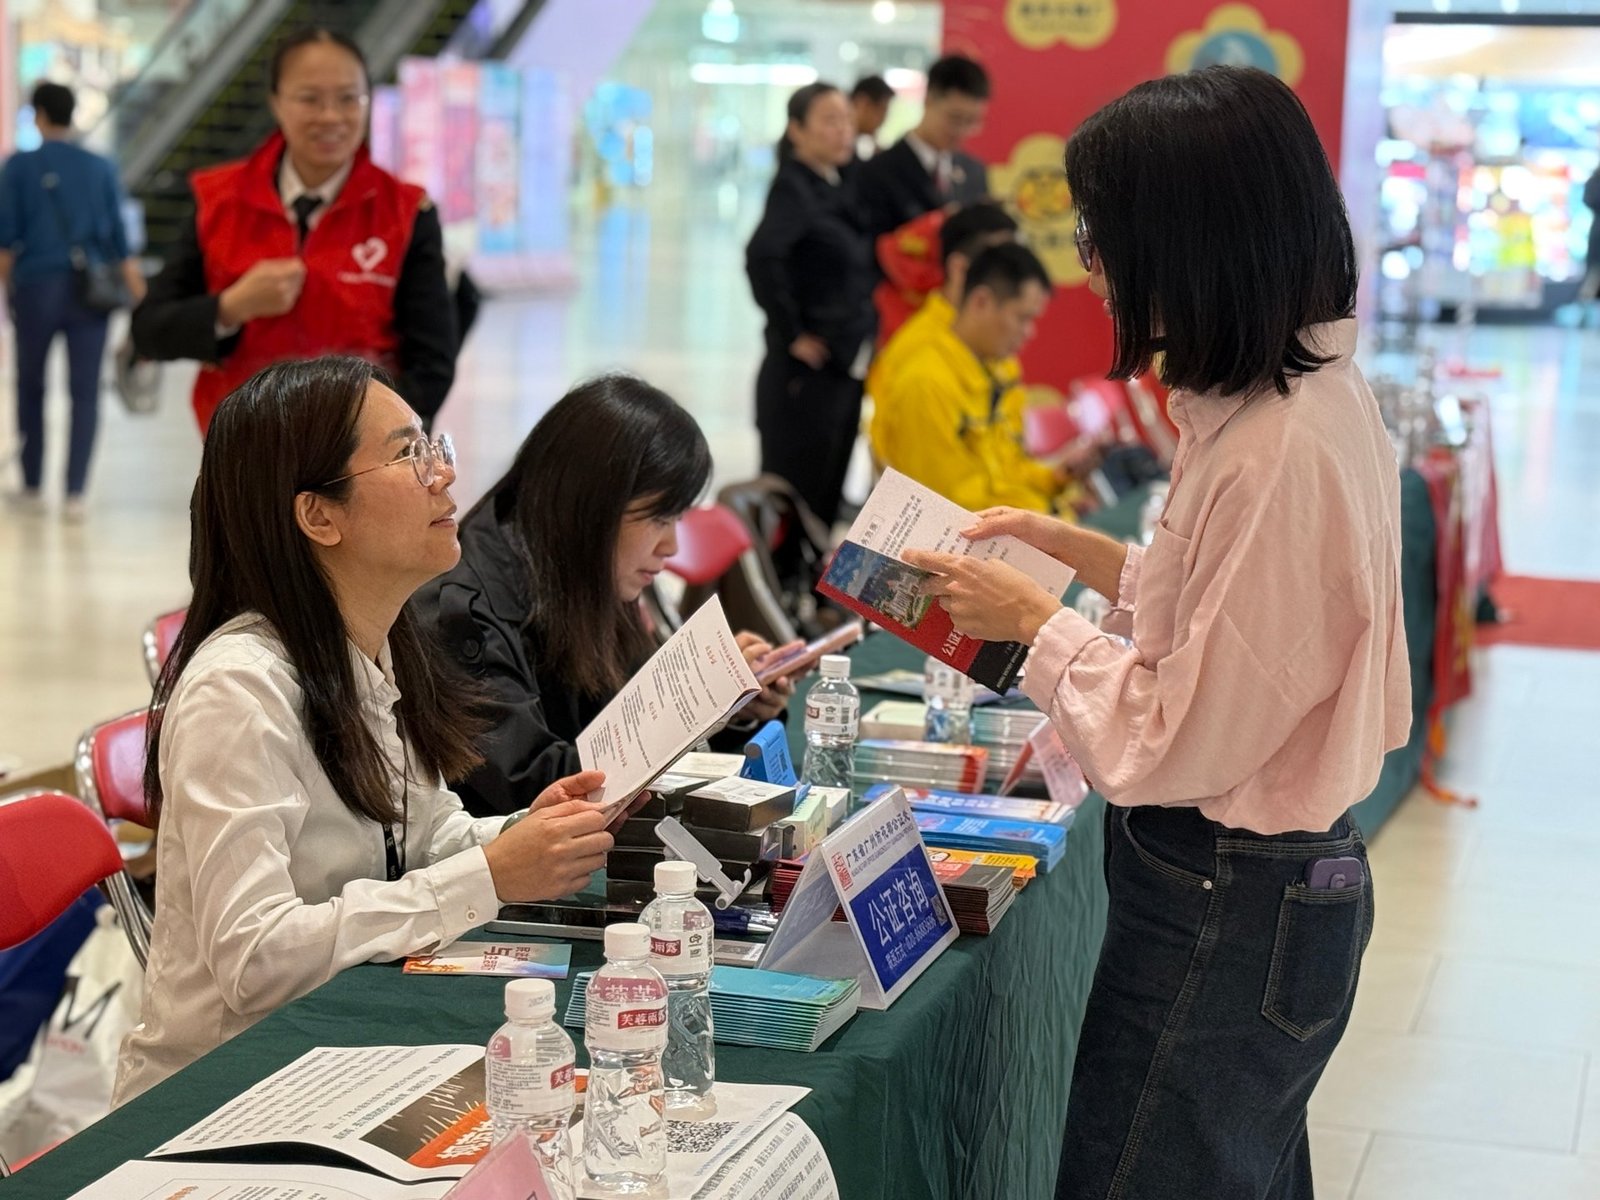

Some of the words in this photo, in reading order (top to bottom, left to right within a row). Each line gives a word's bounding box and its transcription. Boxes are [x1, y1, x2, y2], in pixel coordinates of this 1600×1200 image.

[941, 630, 964, 657] 公证
[867, 867, 930, 948] 公证咨询
[650, 940, 678, 954] 雨露
